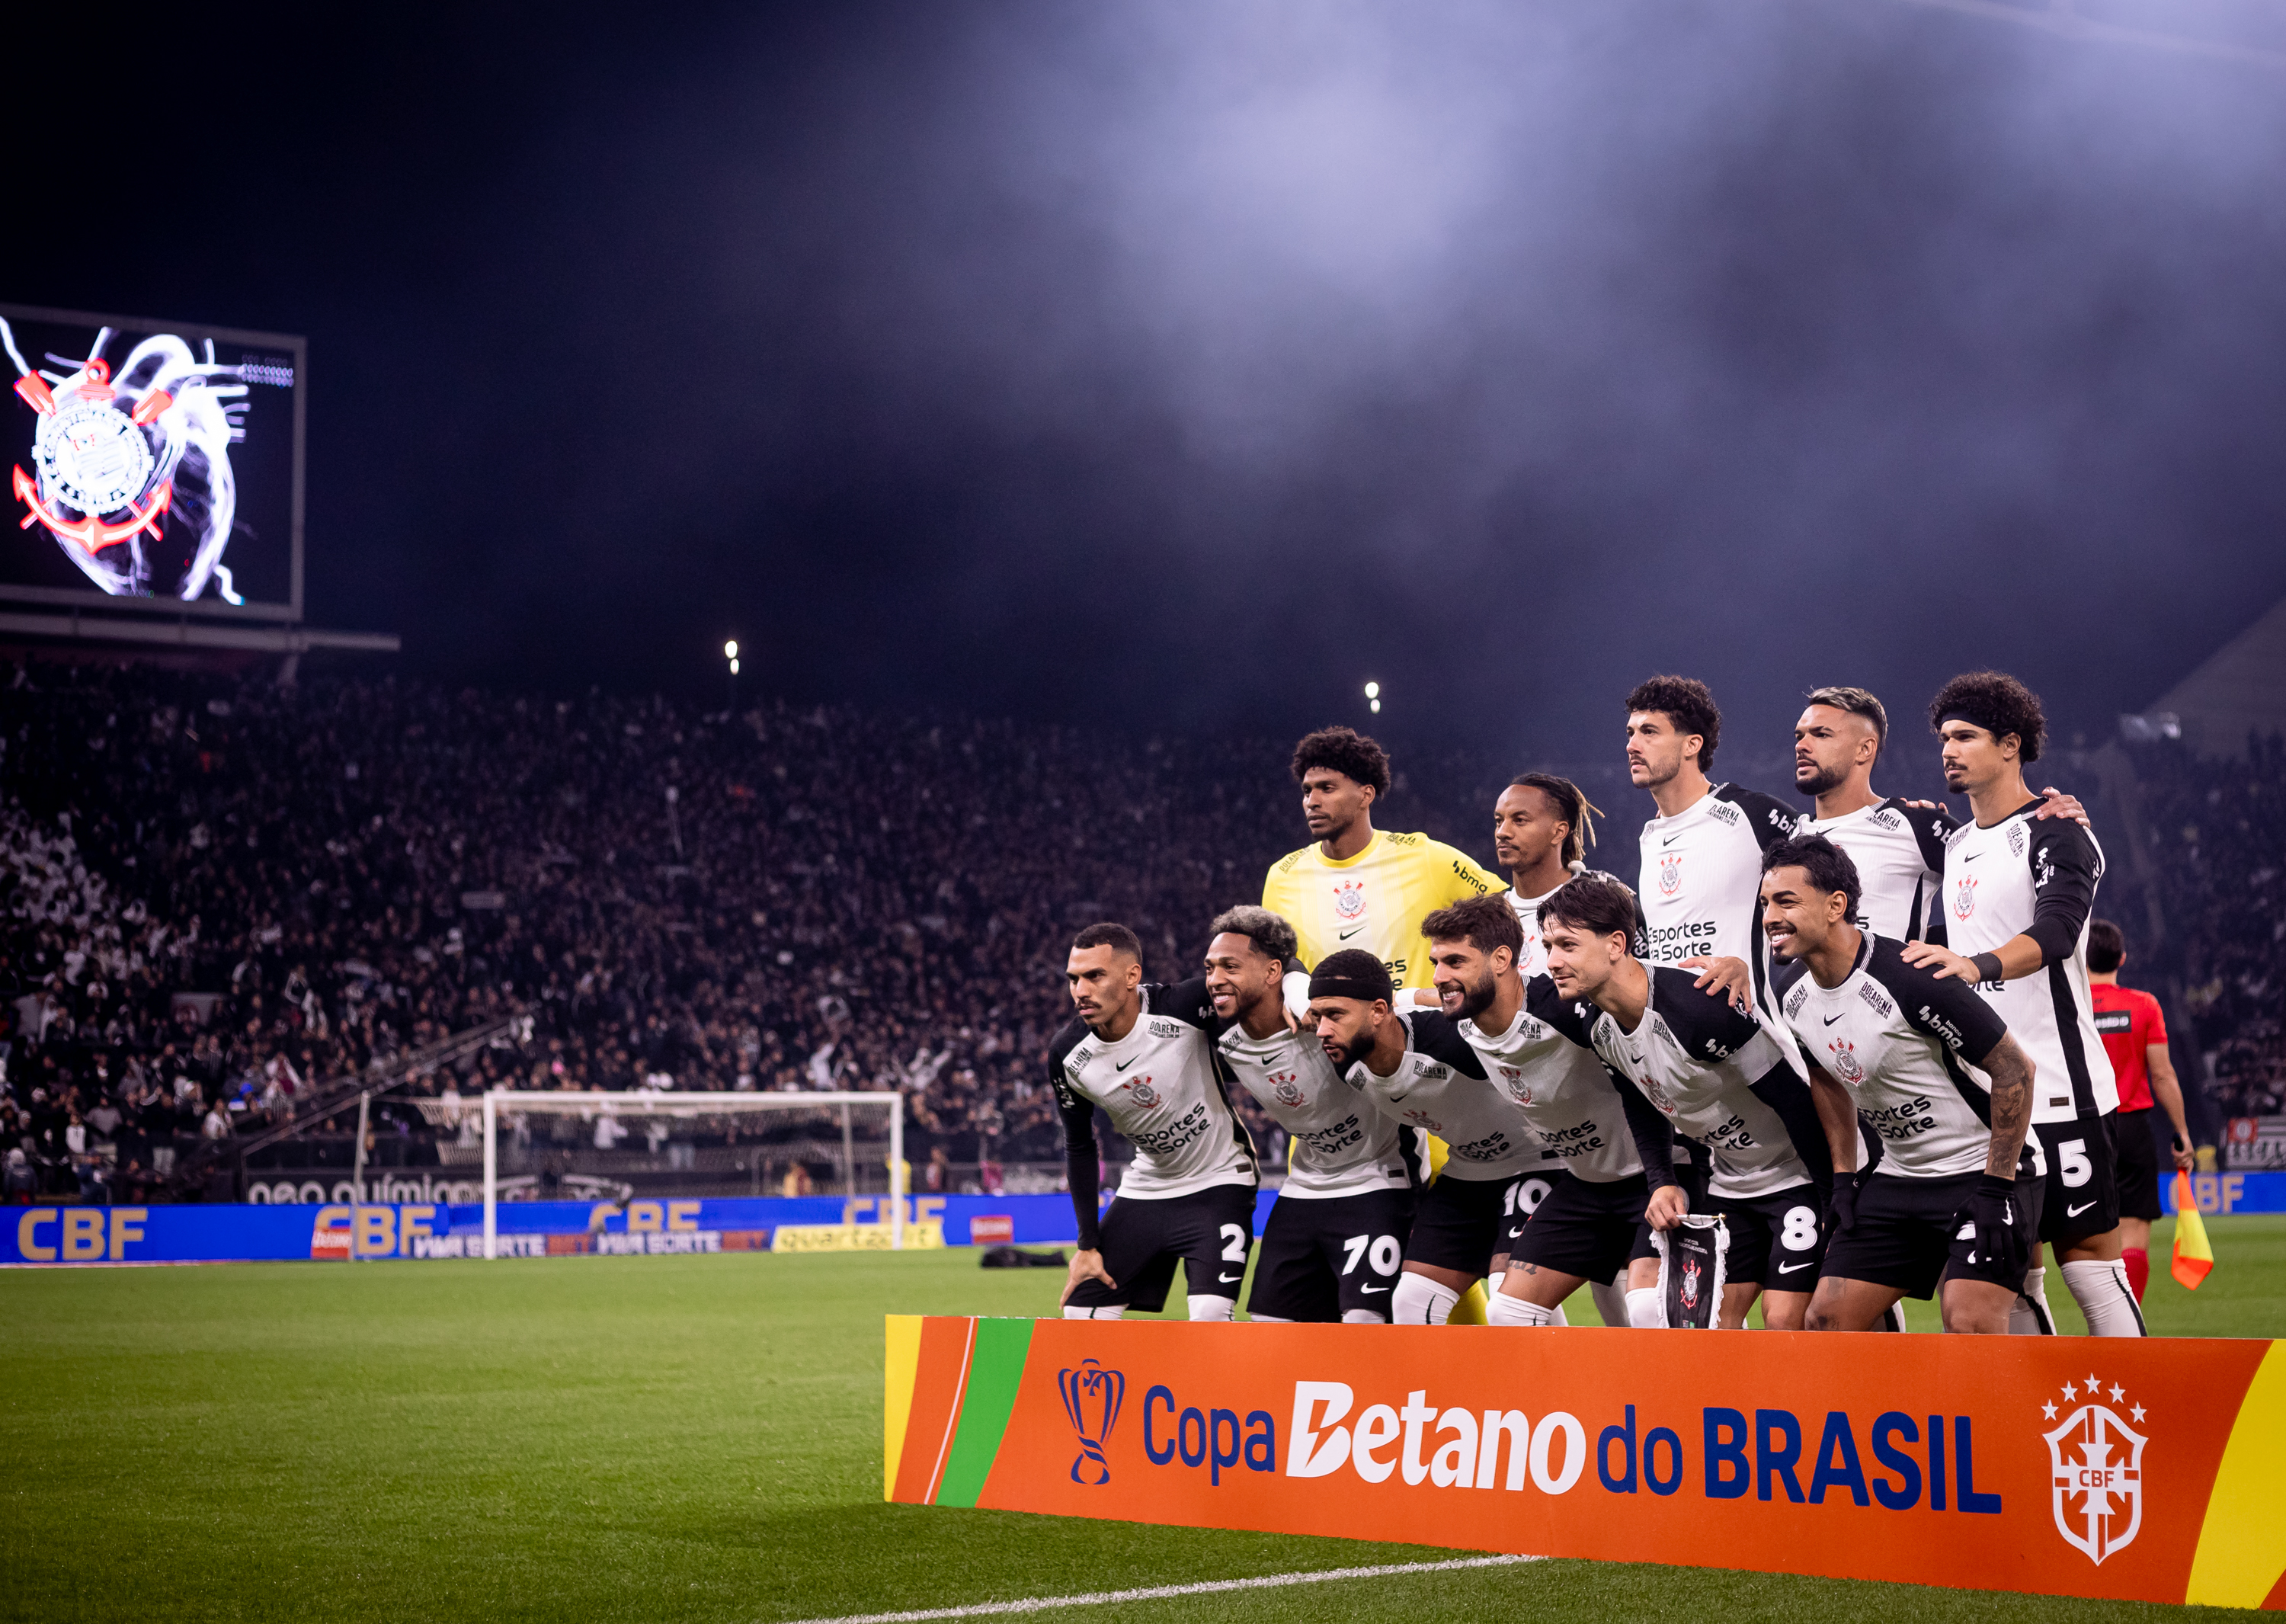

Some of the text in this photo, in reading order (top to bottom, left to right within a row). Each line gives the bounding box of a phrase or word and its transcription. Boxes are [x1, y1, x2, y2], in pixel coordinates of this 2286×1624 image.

[1459, 866, 1488, 897] bmg
[1649, 921, 1717, 947] Esportes
[1862, 981, 1893, 1015] DOEARENA
[1927, 1014, 1964, 1050] bmg
[1945, 1019, 1962, 1037] banco
[1295, 1113, 1359, 1142] portes
[1535, 1120, 1597, 1143] portes
[2058, 1138, 2092, 1188] 5
[1503, 1178, 1553, 1216] 10
[18, 1207, 149, 1261] CBF
[1220, 1223, 1246, 1264] 2
[1780, 1206, 1818, 1251] 8
[1341, 1234, 1401, 1276] 70
[1143, 1381, 2003, 1514] Copa Betano do BRASIL
[2079, 1469, 2115, 1488] CBF
